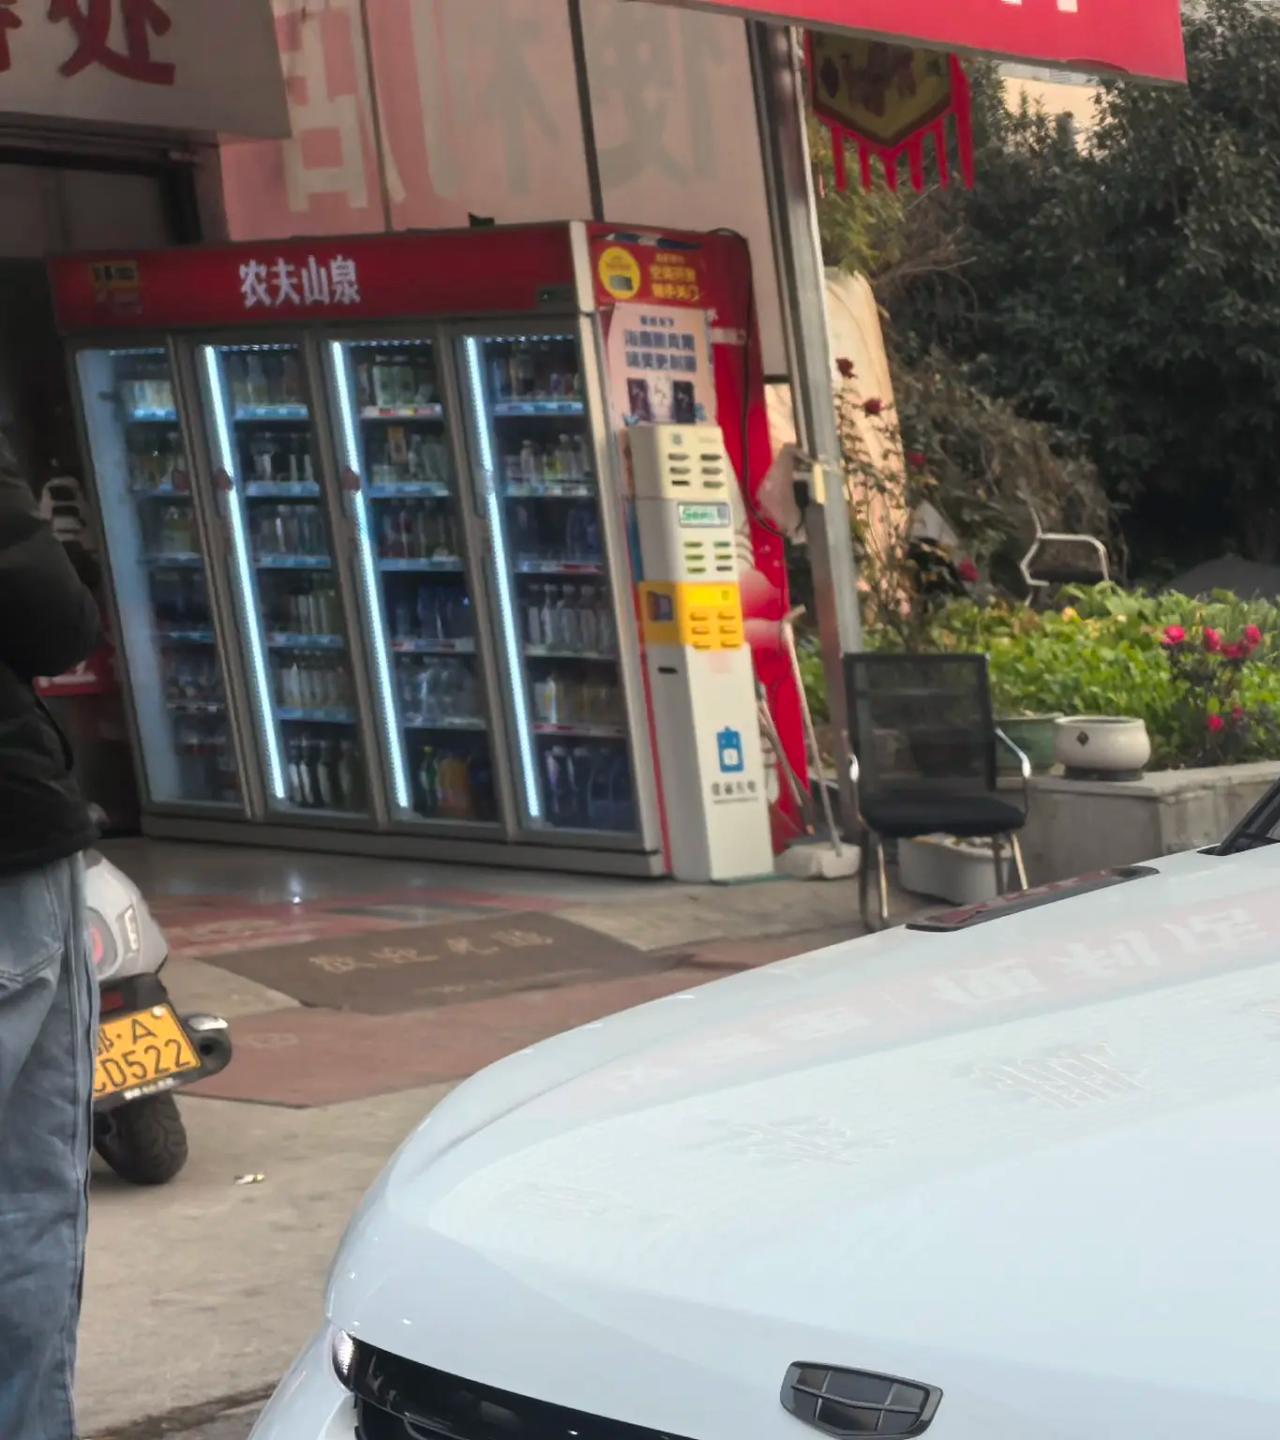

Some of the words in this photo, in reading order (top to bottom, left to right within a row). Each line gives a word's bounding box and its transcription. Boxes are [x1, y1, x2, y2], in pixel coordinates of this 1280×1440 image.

[0, 0, 176, 86] 处
[239, 253, 361, 309] 农夫山泉
